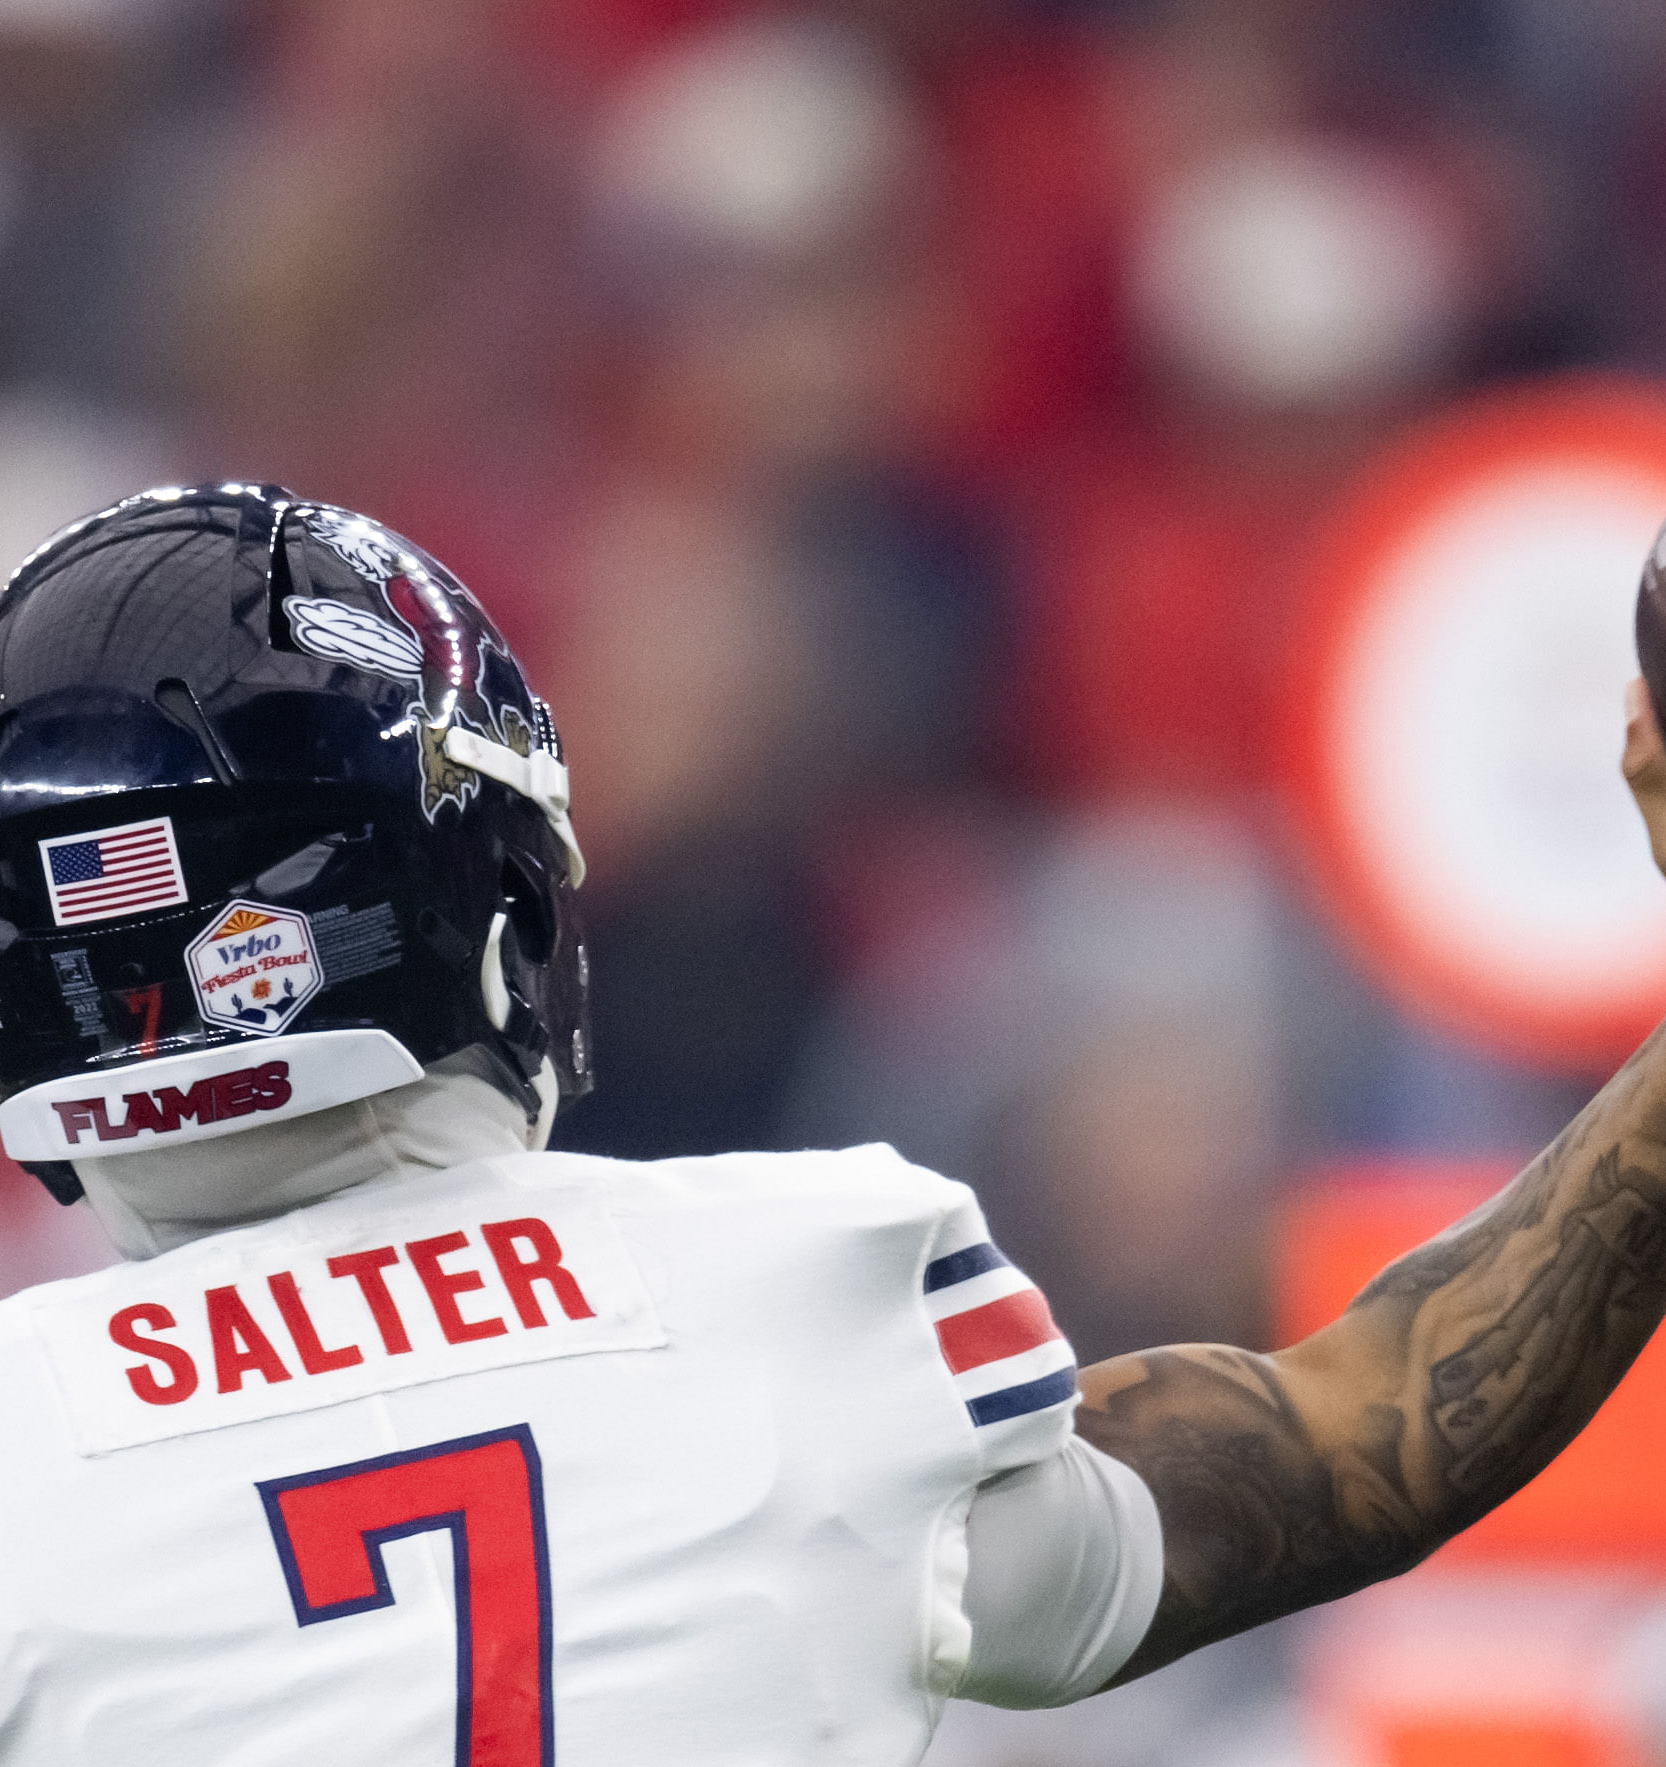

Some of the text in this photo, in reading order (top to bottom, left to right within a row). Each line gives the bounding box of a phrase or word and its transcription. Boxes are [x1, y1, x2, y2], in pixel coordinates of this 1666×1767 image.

[201, 950, 308, 994] Fiesta Bowl
[216, 934, 282, 965] Vrbo
[125, 981, 164, 1060] 7
[51, 1060, 293, 1145] FLAMES
[108, 1217, 598, 1406] SALTER
